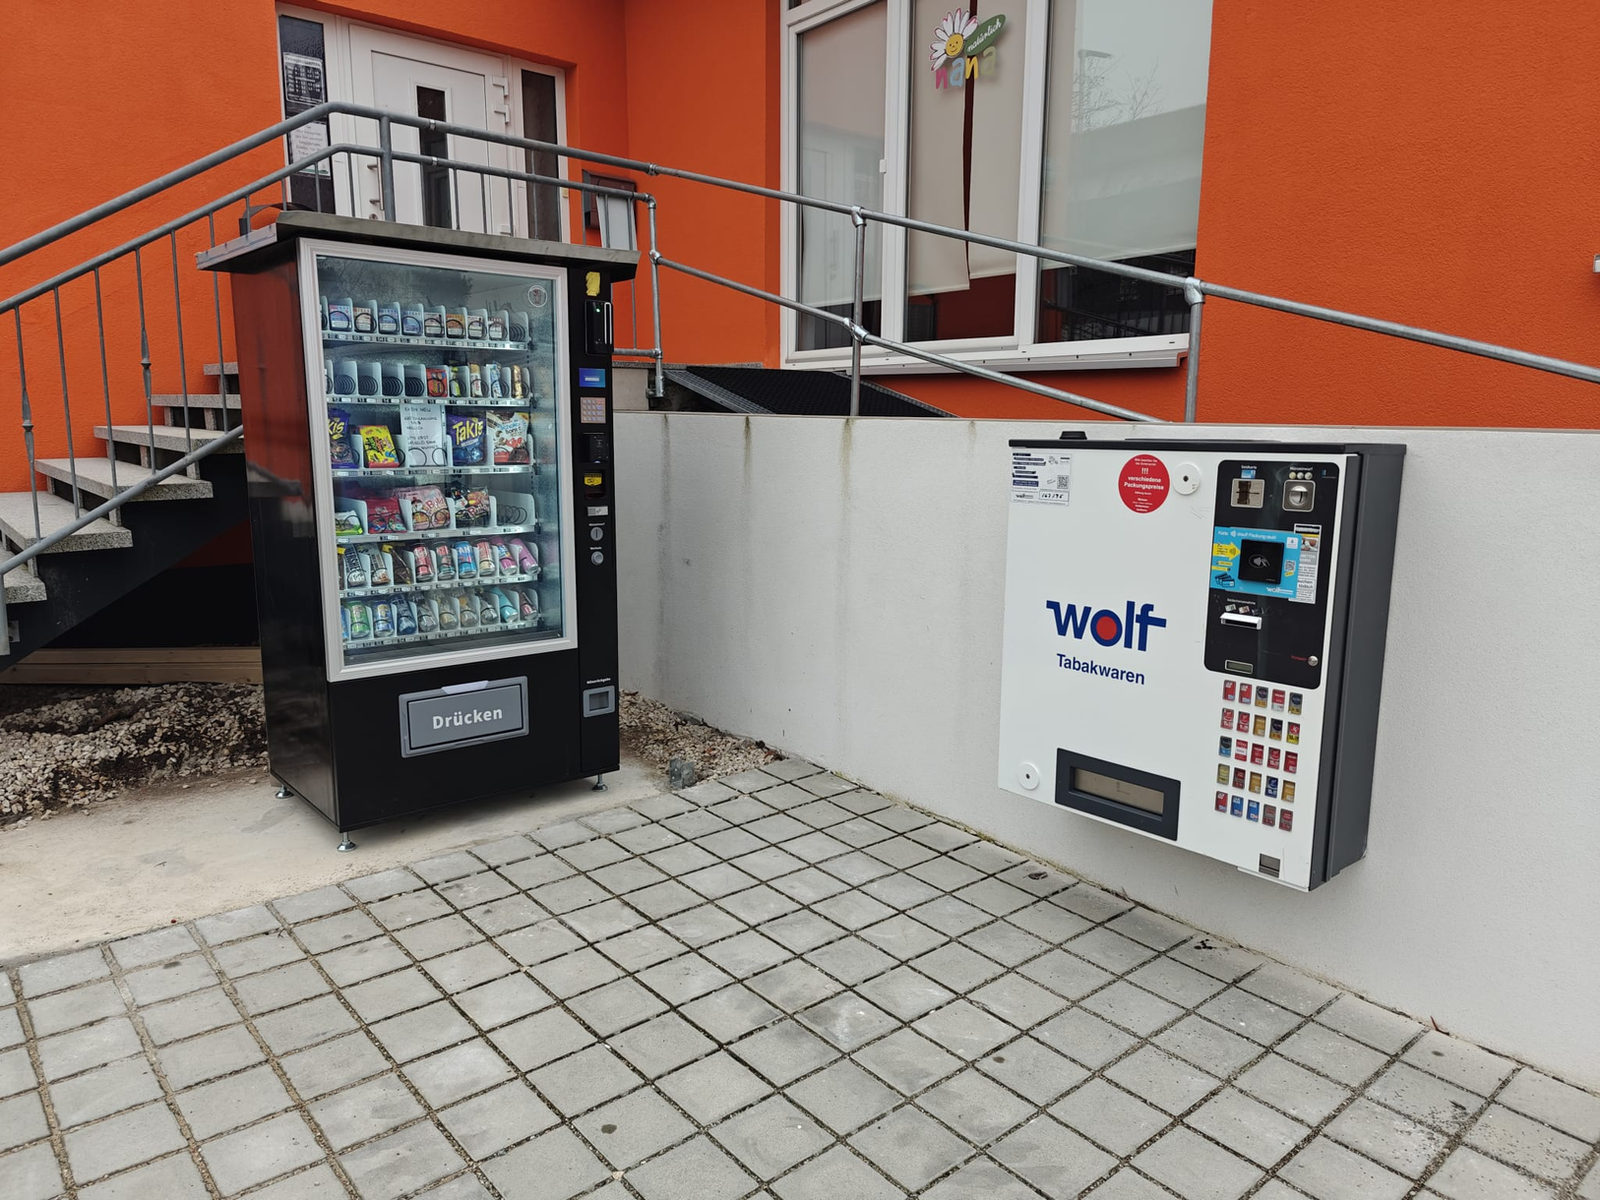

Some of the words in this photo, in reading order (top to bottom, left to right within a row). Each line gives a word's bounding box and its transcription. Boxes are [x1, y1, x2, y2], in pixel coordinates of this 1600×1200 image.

[967, 18, 1002, 53] natürlich
[935, 46, 998, 89] nana
[452, 417, 484, 446] Takis
[1123, 481, 1164, 490] Packungspreise
[1127, 475, 1162, 483] verschiedene
[1046, 600, 1167, 652] wolf
[1056, 653, 1145, 685] Tabakwaren
[432, 708, 503, 730] Drücken
